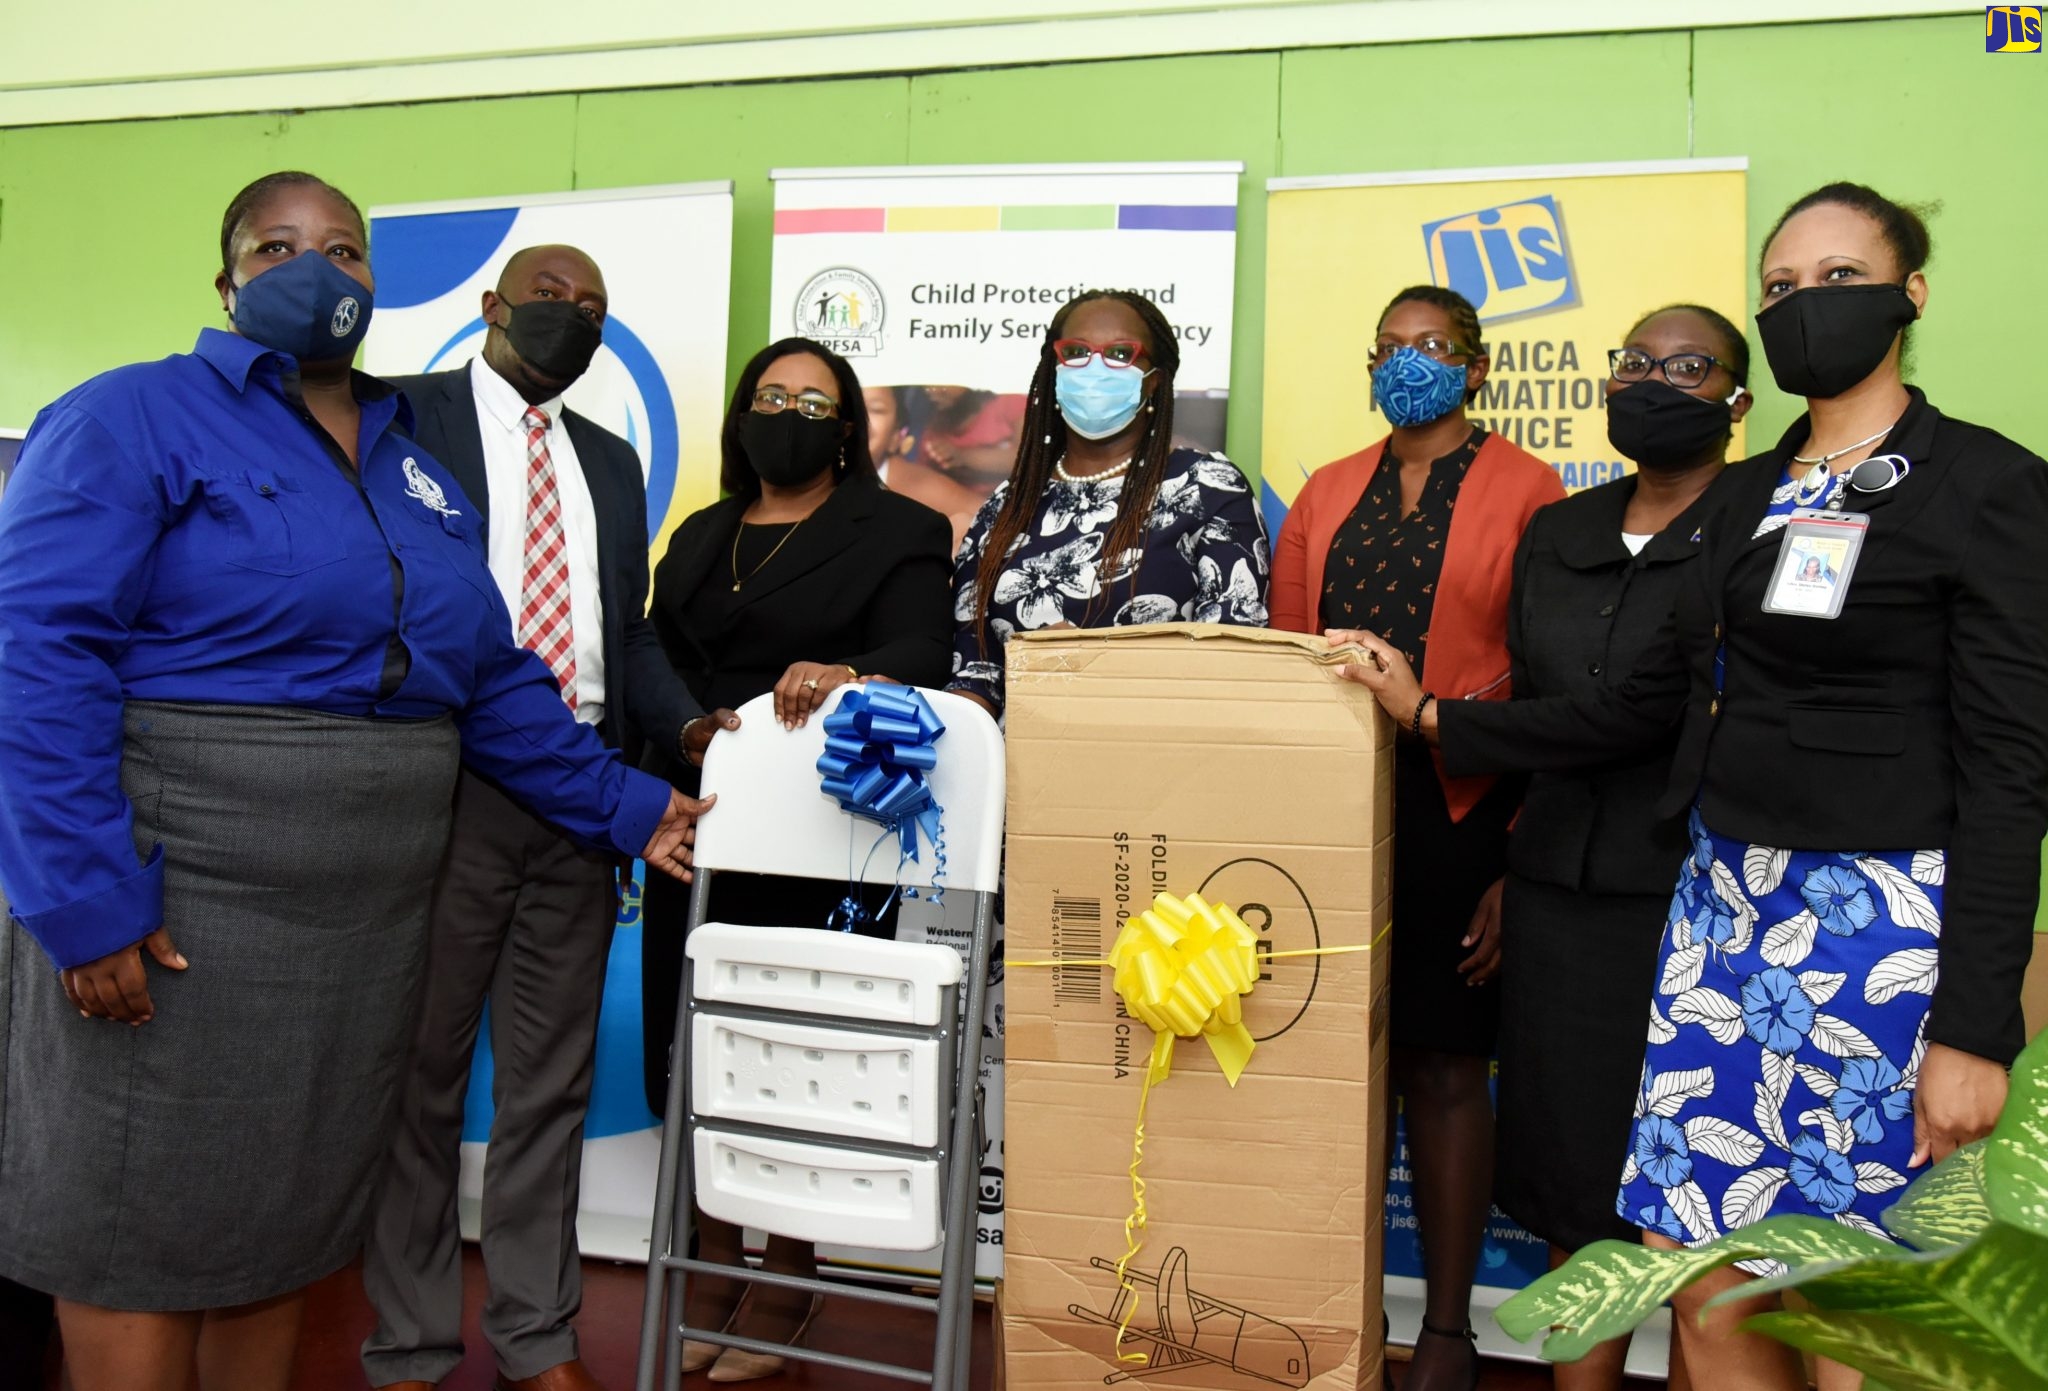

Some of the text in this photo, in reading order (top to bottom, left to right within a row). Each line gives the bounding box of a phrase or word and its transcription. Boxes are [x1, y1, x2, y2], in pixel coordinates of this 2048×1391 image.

[911, 283, 975, 304] Child
[983, 283, 1118, 304] Protecti
[822, 339, 861, 352] PFSA
[909, 317, 993, 344] Family
[1170, 324, 1212, 346] ncy
[1481, 340, 1579, 372] AICA
[1551, 461, 1625, 488] AICA
[926, 926, 973, 938] Western
[1051, 950, 1061, 989] 0001
[1114, 1023, 1131, 1080] CHINA
